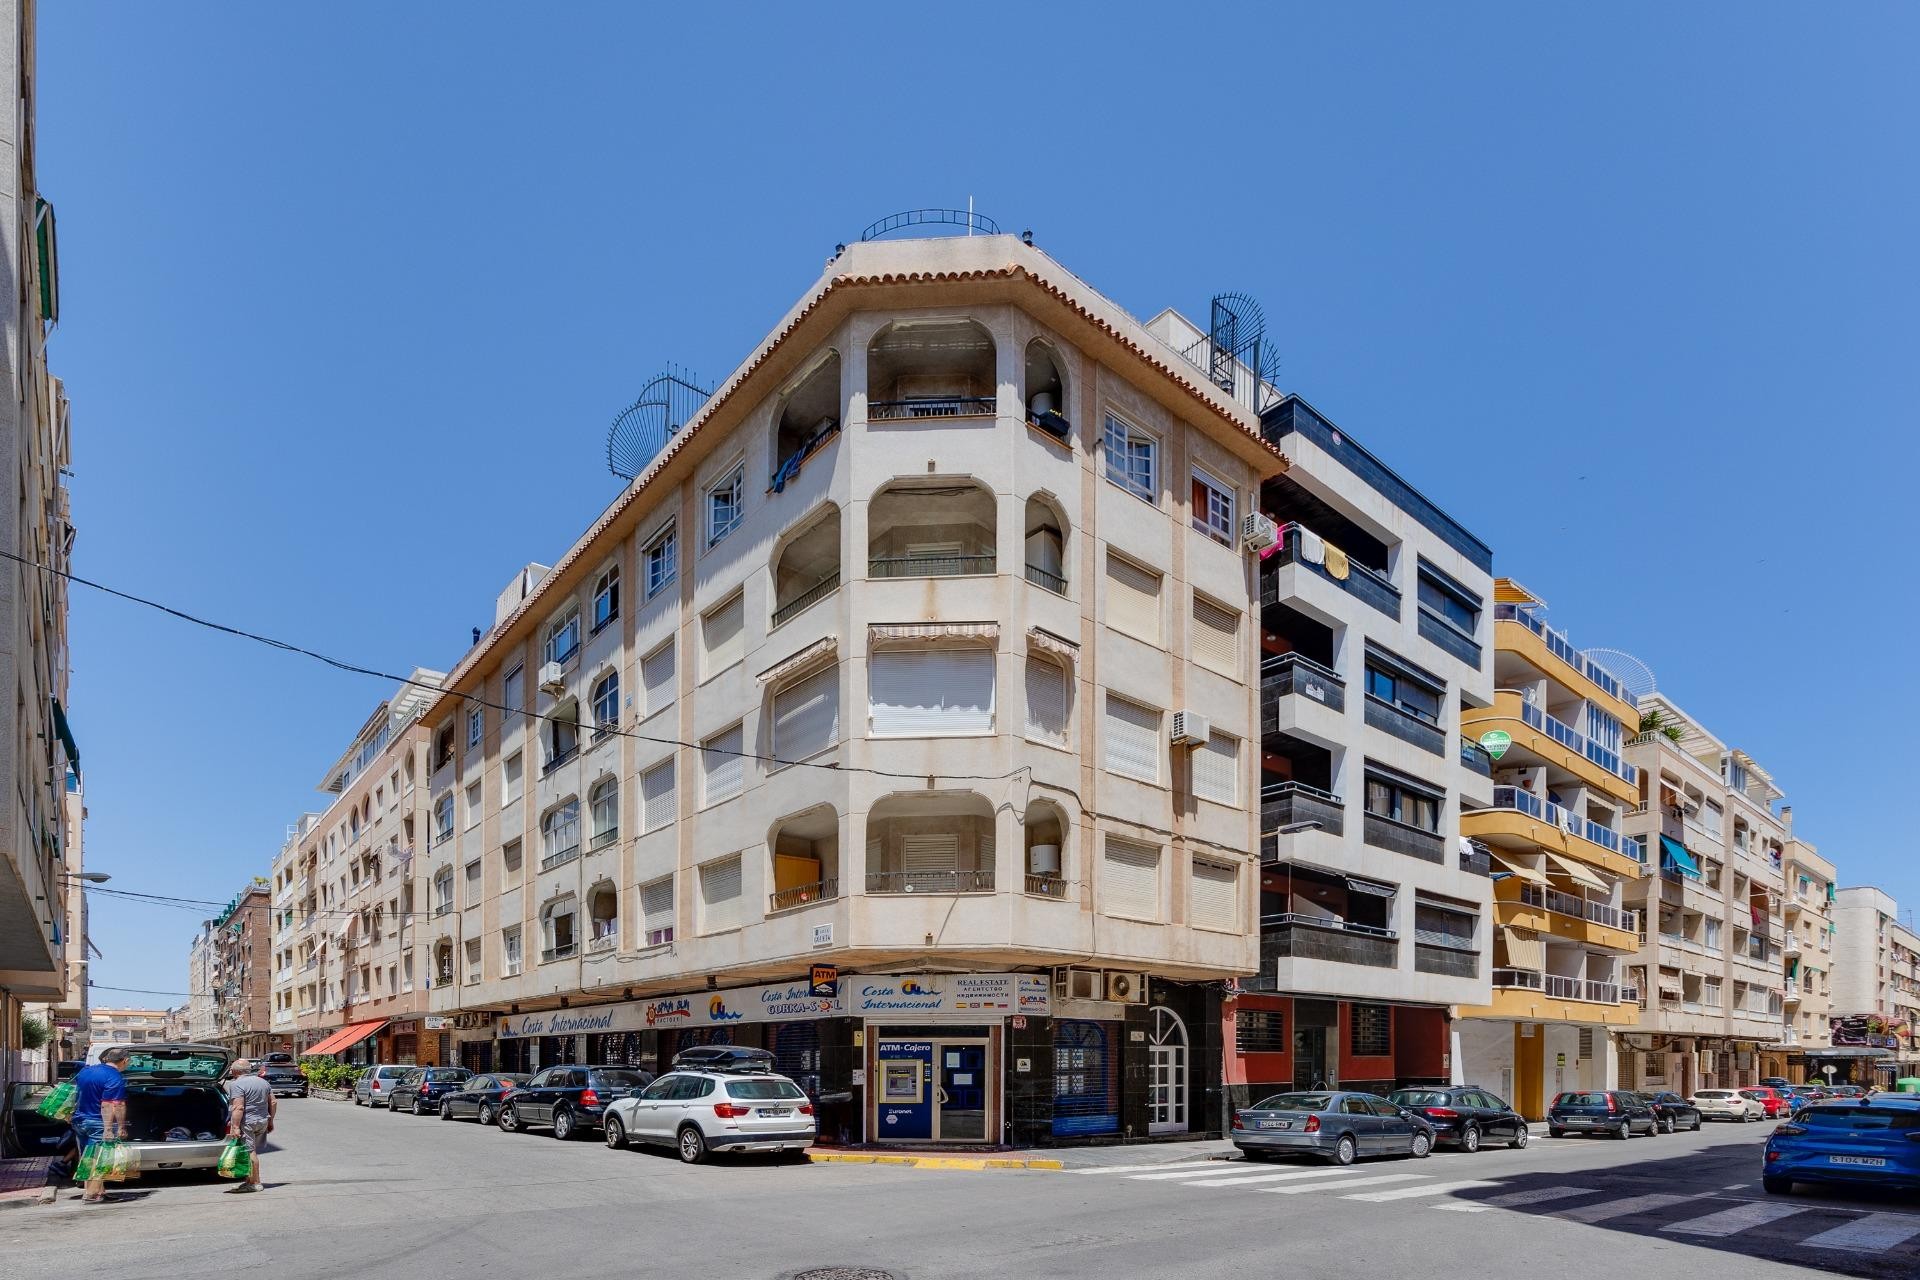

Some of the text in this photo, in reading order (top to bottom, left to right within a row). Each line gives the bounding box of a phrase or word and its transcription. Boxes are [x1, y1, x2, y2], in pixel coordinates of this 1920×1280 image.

[814, 970, 836, 979] ATM
[761, 990, 782, 1002] Costa
[862, 986, 894, 996] Costa
[860, 999, 942, 1010] Internacional
[522, 1008, 614, 1035] Costa Internacional
